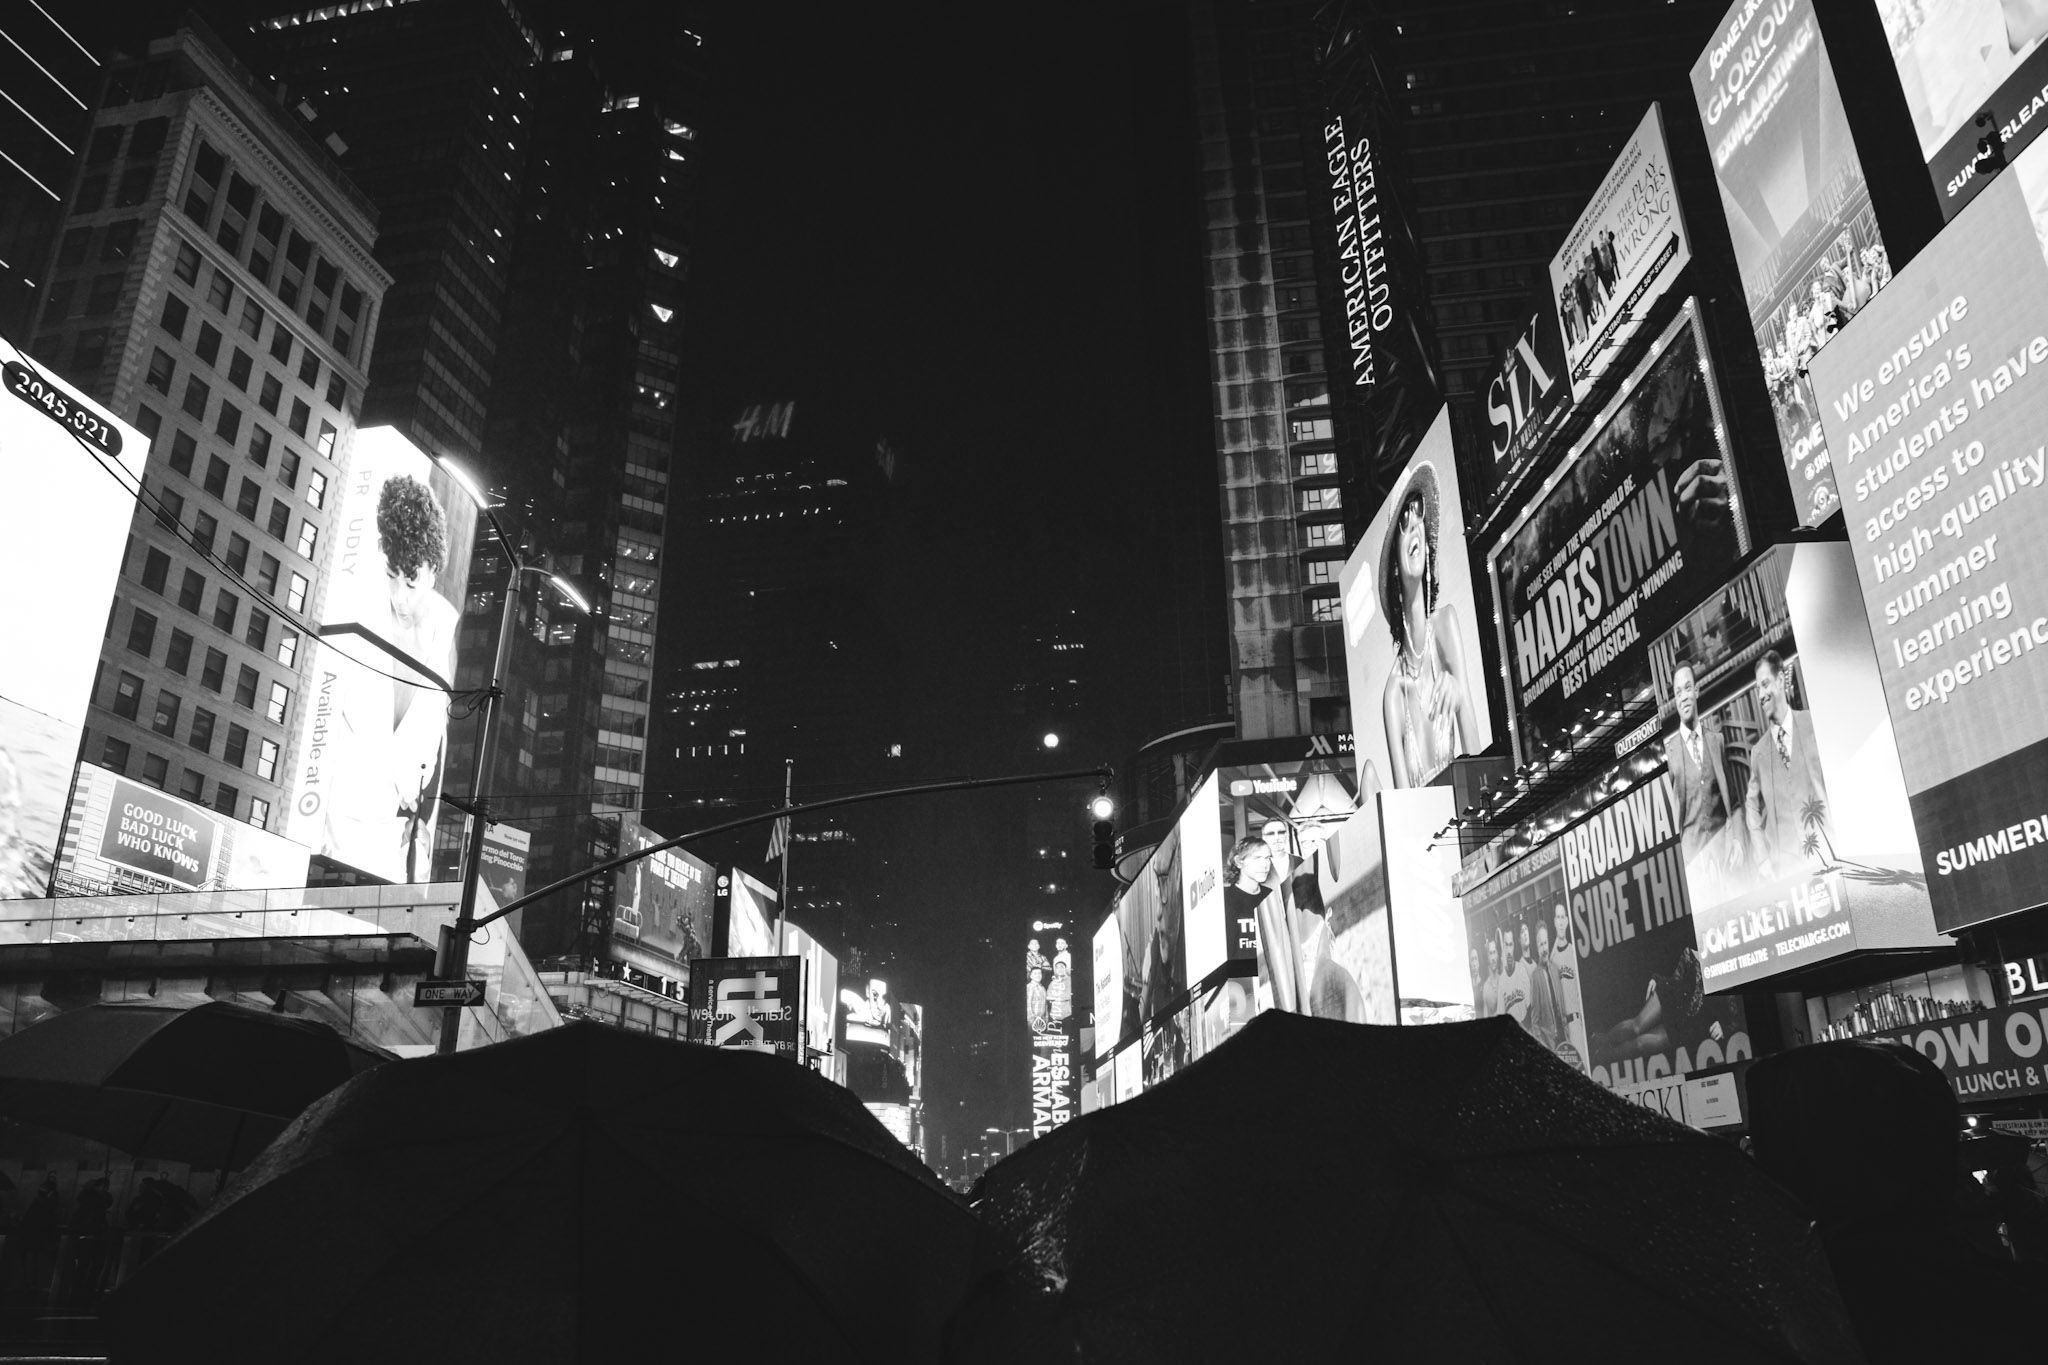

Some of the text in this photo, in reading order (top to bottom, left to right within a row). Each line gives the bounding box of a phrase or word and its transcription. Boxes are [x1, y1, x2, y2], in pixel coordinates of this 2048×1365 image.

[1561, 140, 1639, 261] BROADWAY'S FUNNIEST SMASH HIT
[1563, 148, 1642, 272] AND INTERNATIONAL PHENOMENON
[1616, 208, 1637, 243] THAT
[1636, 165, 1666, 216] GOES
[1617, 196, 1634, 223] THE
[1632, 154, 1656, 202] PLAY
[1619, 190, 1670, 262] WRONG
[1324, 115, 1376, 388] AMERICAN EAGLE
[1351, 137, 1393, 332] OUTFITTERS
[1627, 293, 1638, 309] 340
[1653, 246, 1674, 273] STREET
[1488, 312, 1557, 465] SIX
[1833, 294, 1969, 423] We ensure
[15, 371, 109, 447] 2045.021
[732, 400, 795, 443] H&M
[1509, 408, 1544, 462] THE MUSICAL
[1848, 342, 1973, 464] America's
[1854, 396, 1970, 503] students
[1971, 333, 2048, 411] have
[1864, 462, 1950, 543] access
[1951, 438, 1986, 480] to
[1873, 445, 2048, 584] high-quality
[1514, 467, 1678, 688] HADESTOWN
[1526, 572, 1543, 600] COME
[1542, 561, 1554, 584] SEE
[1552, 546, 1568, 573] HOW
[1566, 532, 1580, 557] THE
[1578, 509, 1603, 544] WORLD
[1601, 485, 1625, 520] COULD
[1884, 533, 1999, 626] summer
[1561, 616, 1641, 700] BEST MUSICAL
[1892, 581, 2014, 669] learning
[1523, 658, 1565, 708] BROADWAY'S
[1564, 638, 1585, 670] TONY
[1585, 624, 1602, 652] AND
[305, 671, 338, 786] Available at
[1617, 718, 1658, 755] OUTFRONT
[123, 803, 198, 843] GOOD LUCK
[1252, 777, 1298, 794] YouTube
[117, 831, 200, 873] WHO KNOWS
[120, 817, 185, 851] BAD LUCK
[493, 856, 524, 872] Pinocchio
[1564, 772, 1680, 890] BROADWAY
[717, 889, 728, 897] LG
[1573, 870, 1635, 959] SURE
[1791, 870, 1842, 926] HOT
[1738, 947, 1769, 969] THEATRE
[1775, 920, 1851, 956] TELECHARGE.COM
[425, 988, 475, 999] ONE WAY
[716, 970, 781, 1055] tk
[2005, 1005, 2048, 1058] O
[1051, 1053, 1071, 1130] ESLAB
[1955, 1066, 2040, 1096] LUNCH &
